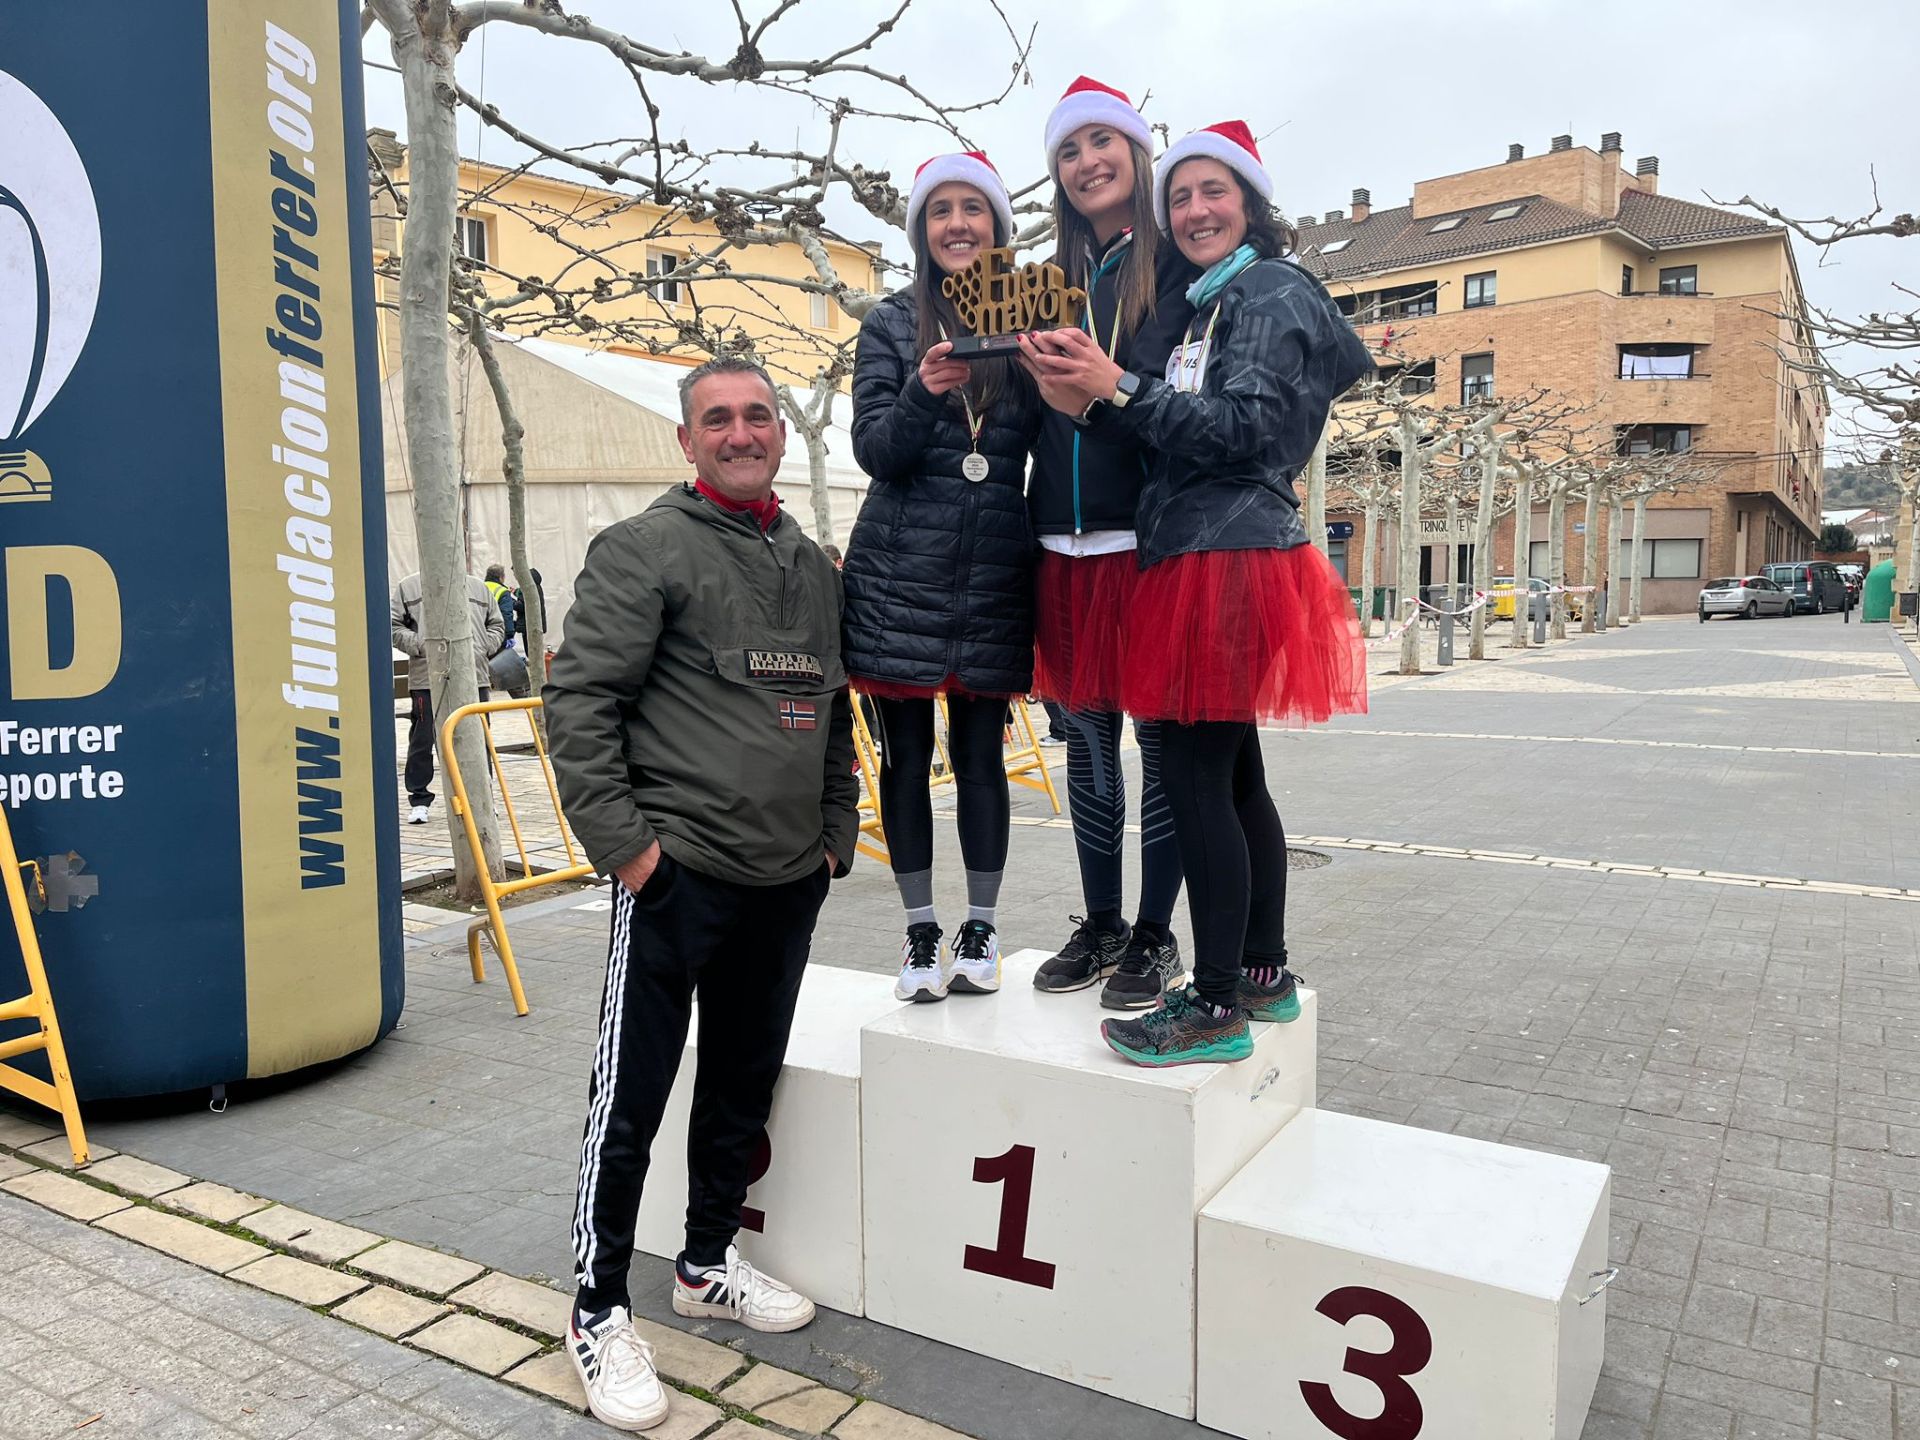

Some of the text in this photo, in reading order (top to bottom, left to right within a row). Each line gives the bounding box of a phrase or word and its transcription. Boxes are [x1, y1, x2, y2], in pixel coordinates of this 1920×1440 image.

[979, 247, 1065, 304] Fuen
[973, 286, 1087, 337] mayor
[265, 20, 346, 889] www.fundacionferrer.org
[1419, 519, 1466, 533] TRINQUTE
[0, 720, 123, 755] Ferrer
[963, 1143, 1056, 1290] 1
[1298, 1285, 1433, 1440] 3
